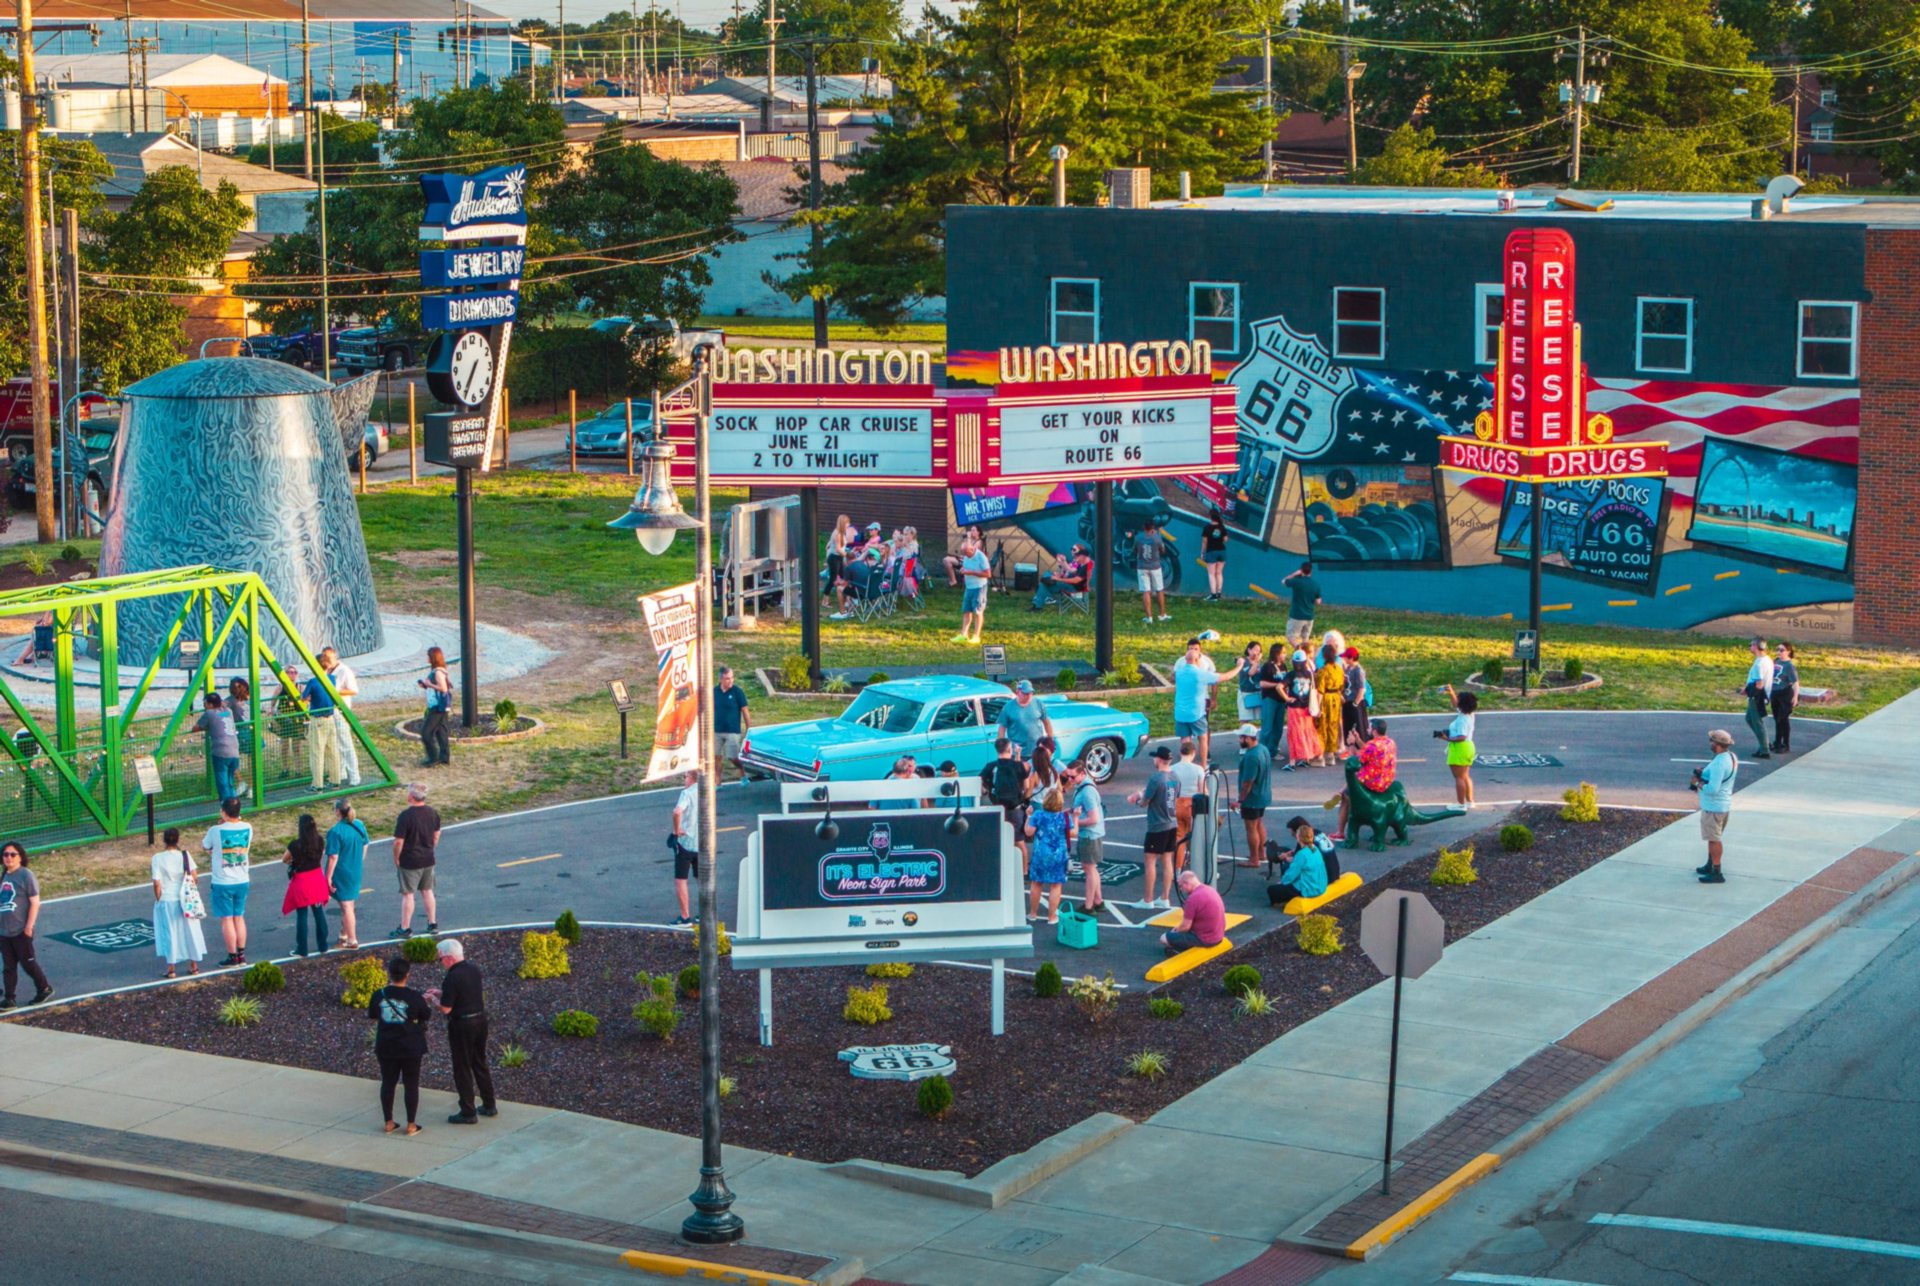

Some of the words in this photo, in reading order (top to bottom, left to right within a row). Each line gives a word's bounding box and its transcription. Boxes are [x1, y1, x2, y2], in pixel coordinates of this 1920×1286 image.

[448, 250, 523, 279] JEWELRY
[449, 295, 516, 323] DIAMONDS
[461, 340, 467, 350] 11
[469, 335, 476, 345] 12
[479, 337, 483, 348] 1
[456, 352, 462, 361] 10
[484, 347, 489, 357] 2
[1265, 330, 1343, 385] ILLINOIS
[1511, 261, 1527, 439] REESE
[1542, 261, 1564, 440] REESE
[487, 361, 492, 372] 3
[1001, 339, 1211, 383] WASHINGTON
[453, 366, 458, 376] 9
[485, 377, 490, 386] 4
[471, 393, 476, 403] 6
[479, 388, 484, 398] 5
[1041, 413, 1069, 428] GET
[1081, 411, 1123, 426] YOUR
[1132, 407, 1176, 424] KICKS
[1243, 379, 1312, 445] 66
[715, 416, 758, 431] SOCK
[775, 416, 808, 431] HOP
[819, 416, 851, 432] CAR
[861, 417, 919, 432] CRUISE
[768, 434, 808, 450] JUNE
[824, 434, 839, 449] 21
[1099, 429, 1119, 443] ON
[753, 453, 763, 468] 2
[772, 453, 793, 468] TO
[806, 453, 880, 468] TWILIGHT
[1065, 447, 1114, 464] ROUTE
[1123, 445, 1142, 461] 66
[1453, 443, 1520, 475] DRUGS
[1548, 448, 1646, 476] DRUGS
[1580, 479, 1604, 494] OF
[1608, 480, 1650, 505] ROCKS
[980, 496, 1006, 513] TWIST
[982, 511, 1003, 520] CREAM
[1450, 516, 1495, 530] Madison
[1601, 522, 1644, 546] 66
[1580, 549, 1617, 562] AUTO
[1622, 552, 1650, 565] COU
[653, 627, 667, 646] ON
[666, 620, 688, 643] ROUTE
[1809, 620, 1836, 630] Louis
[674, 662, 687, 685] 66
[825, 864, 854, 881] IT'S
[858, 861, 938, 879] ELECTRIC
[838, 878, 868, 890] Neon
[869, 876, 896, 895] Sign
[898, 873, 927, 888] Park
[857, 1045, 931, 1053] ILLINOIS
[871, 1056, 934, 1070] 66
